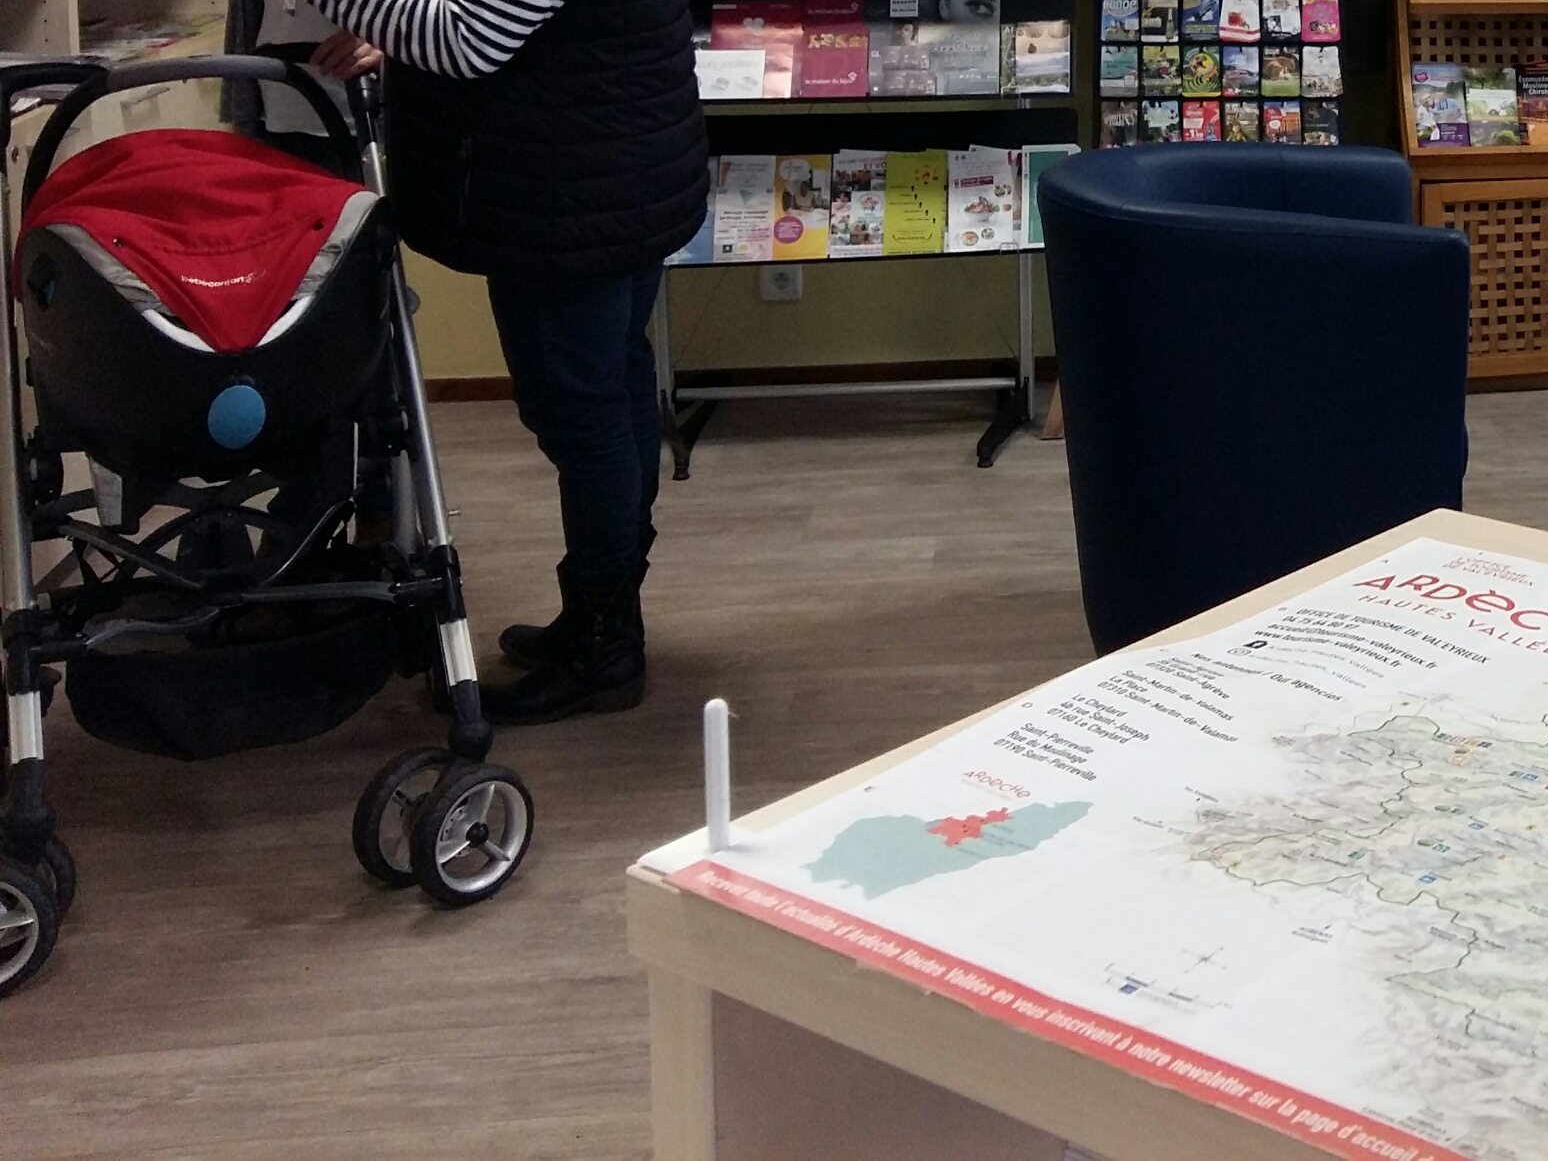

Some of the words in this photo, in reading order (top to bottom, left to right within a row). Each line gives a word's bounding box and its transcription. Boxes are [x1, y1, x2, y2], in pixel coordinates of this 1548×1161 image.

[1358, 594, 1458, 621] HAUTES
[1296, 608, 1337, 618] OFFICE
[1351, 615, 1405, 632] TOURISME
[1403, 627, 1422, 638] DE
[1420, 633, 1491, 665] VAL'EYRIEUX
[1269, 673, 1292, 684] Our
[1290, 678, 1343, 702] agencies
[1072, 693, 1086, 703] Le
[1084, 698, 1129, 718] Cheylard
[1006, 730, 1028, 743] Rue
[1025, 739, 1041, 748] du
[1020, 722, 1096, 756] Saint-Pierreville
[1071, 706, 1091, 716] rue
[1089, 711, 1151, 742] Saint-Joseph
[1074, 717, 1089, 728] Le
[1086, 723, 1132, 745] Cheylard
[1022, 749, 1098, 782] Saint-Pierreville
[896, 947, 948, 978] Hautes
[990, 988, 1016, 1006] en
[1011, 996, 1050, 1021] vous
[1044, 1008, 1123, 1046] inscrivant
[1126, 1034, 1173, 1068] notre
[1167, 1055, 1252, 1099] newsletter
[1246, 1086, 1283, 1112] sur
[1276, 1098, 1299, 1117] la
[1290, 1103, 1340, 1135] page
